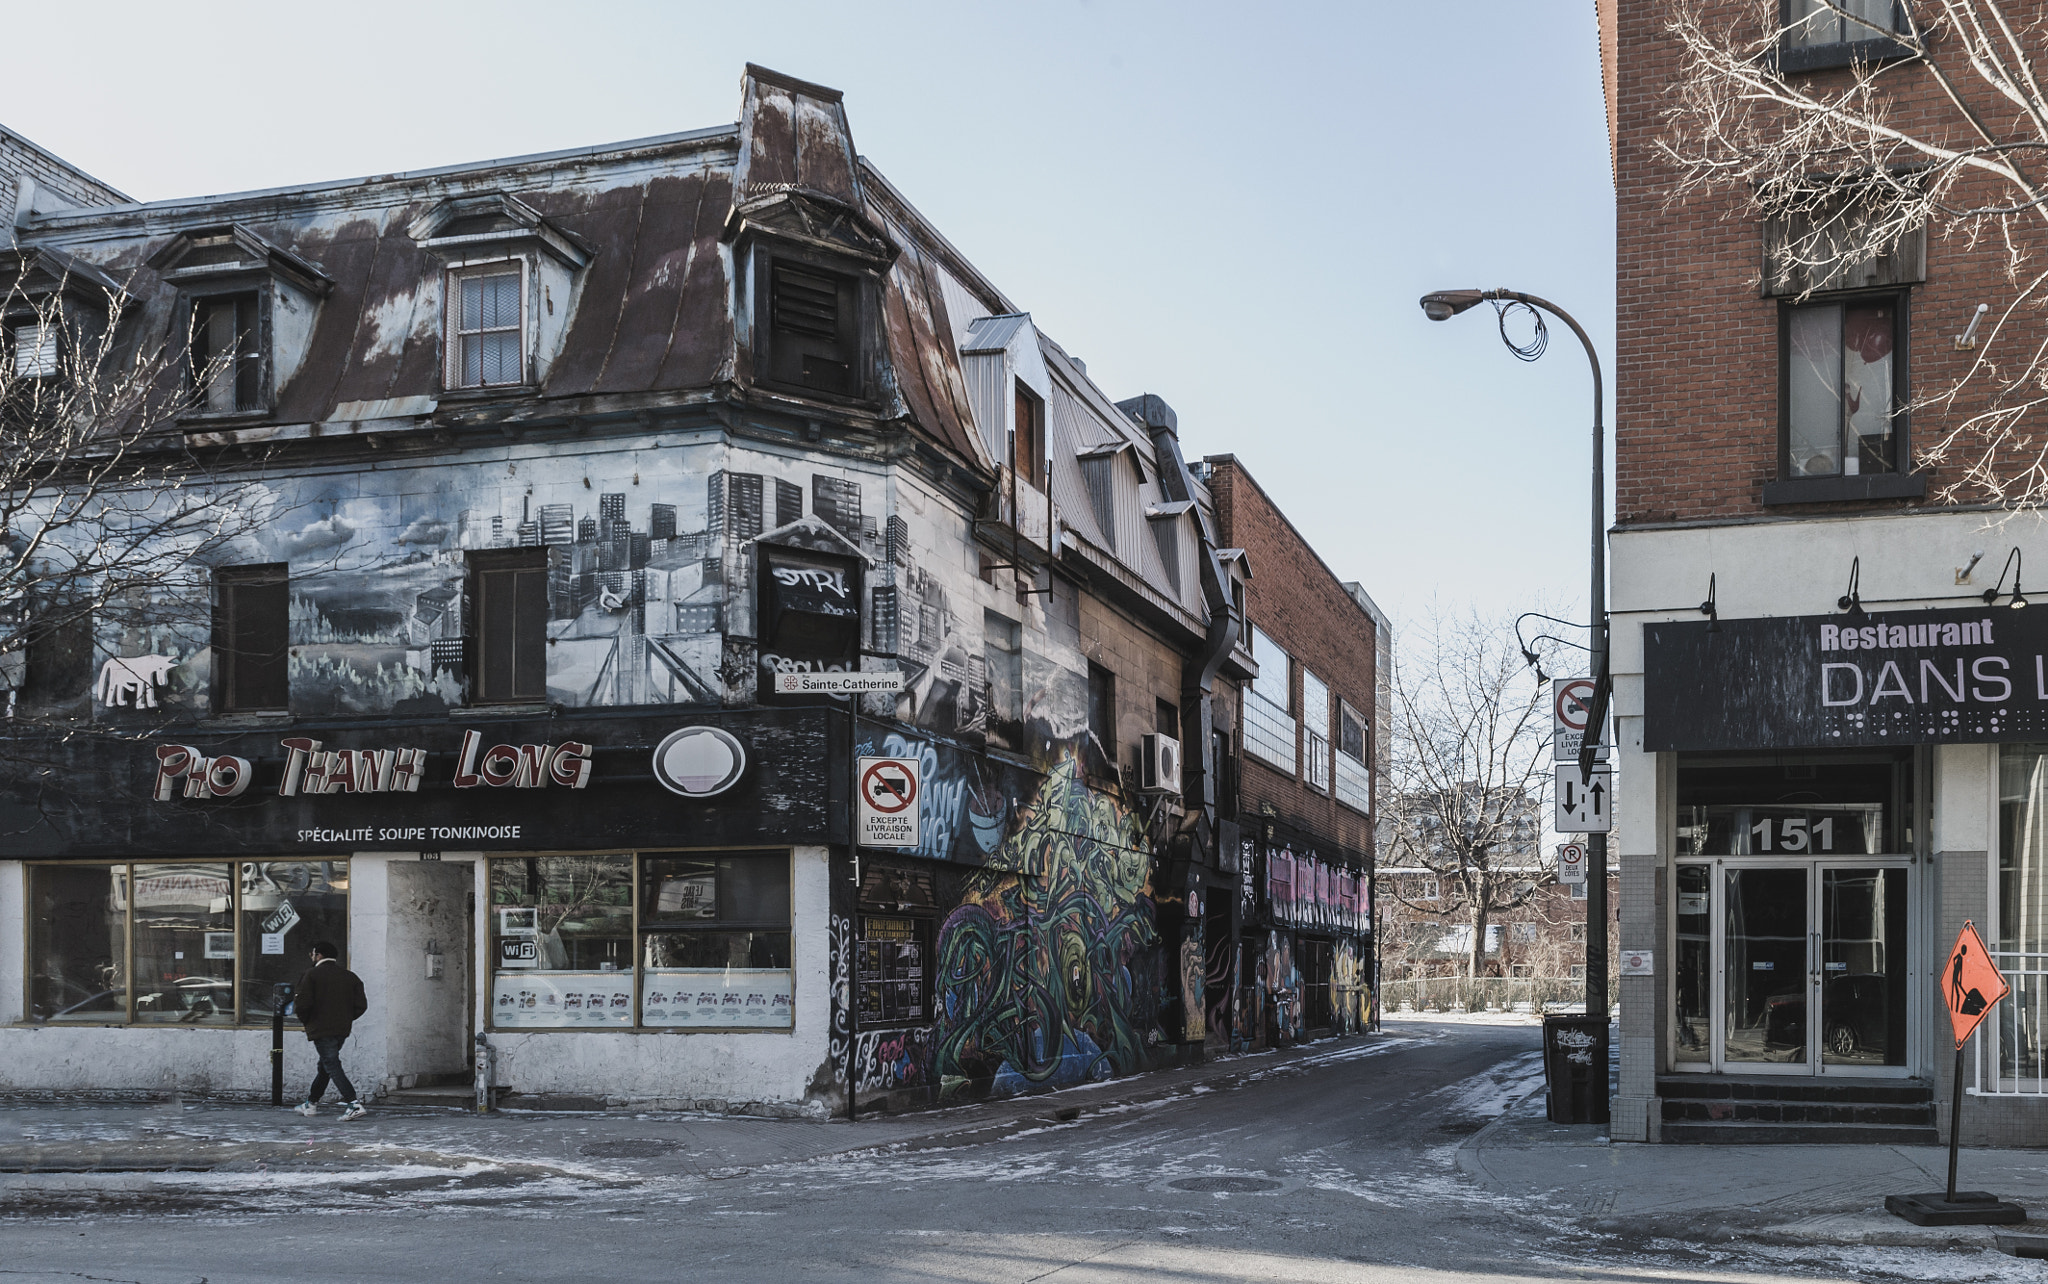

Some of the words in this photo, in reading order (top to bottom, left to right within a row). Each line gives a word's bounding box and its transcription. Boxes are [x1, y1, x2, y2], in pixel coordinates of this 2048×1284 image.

[1820, 618, 1995, 651] Restaurant
[802, 678, 899, 691] Sainte-Catherine
[1821, 656, 2012, 707] DANS
[154, 744, 252, 801] PHO
[279, 737, 428, 796] THANH
[454, 729, 592, 789] LONG
[866, 824, 912, 832] LIVRAISON
[870, 816, 908, 825] EXCEPTÉ
[297, 826, 373, 842] SPÉCIALITÉ
[379, 827, 426, 841] SOUPE
[430, 825, 521, 840] TONKINOISE
[873, 832, 906, 840] LOCALE
[1752, 817, 1833, 851] 151
